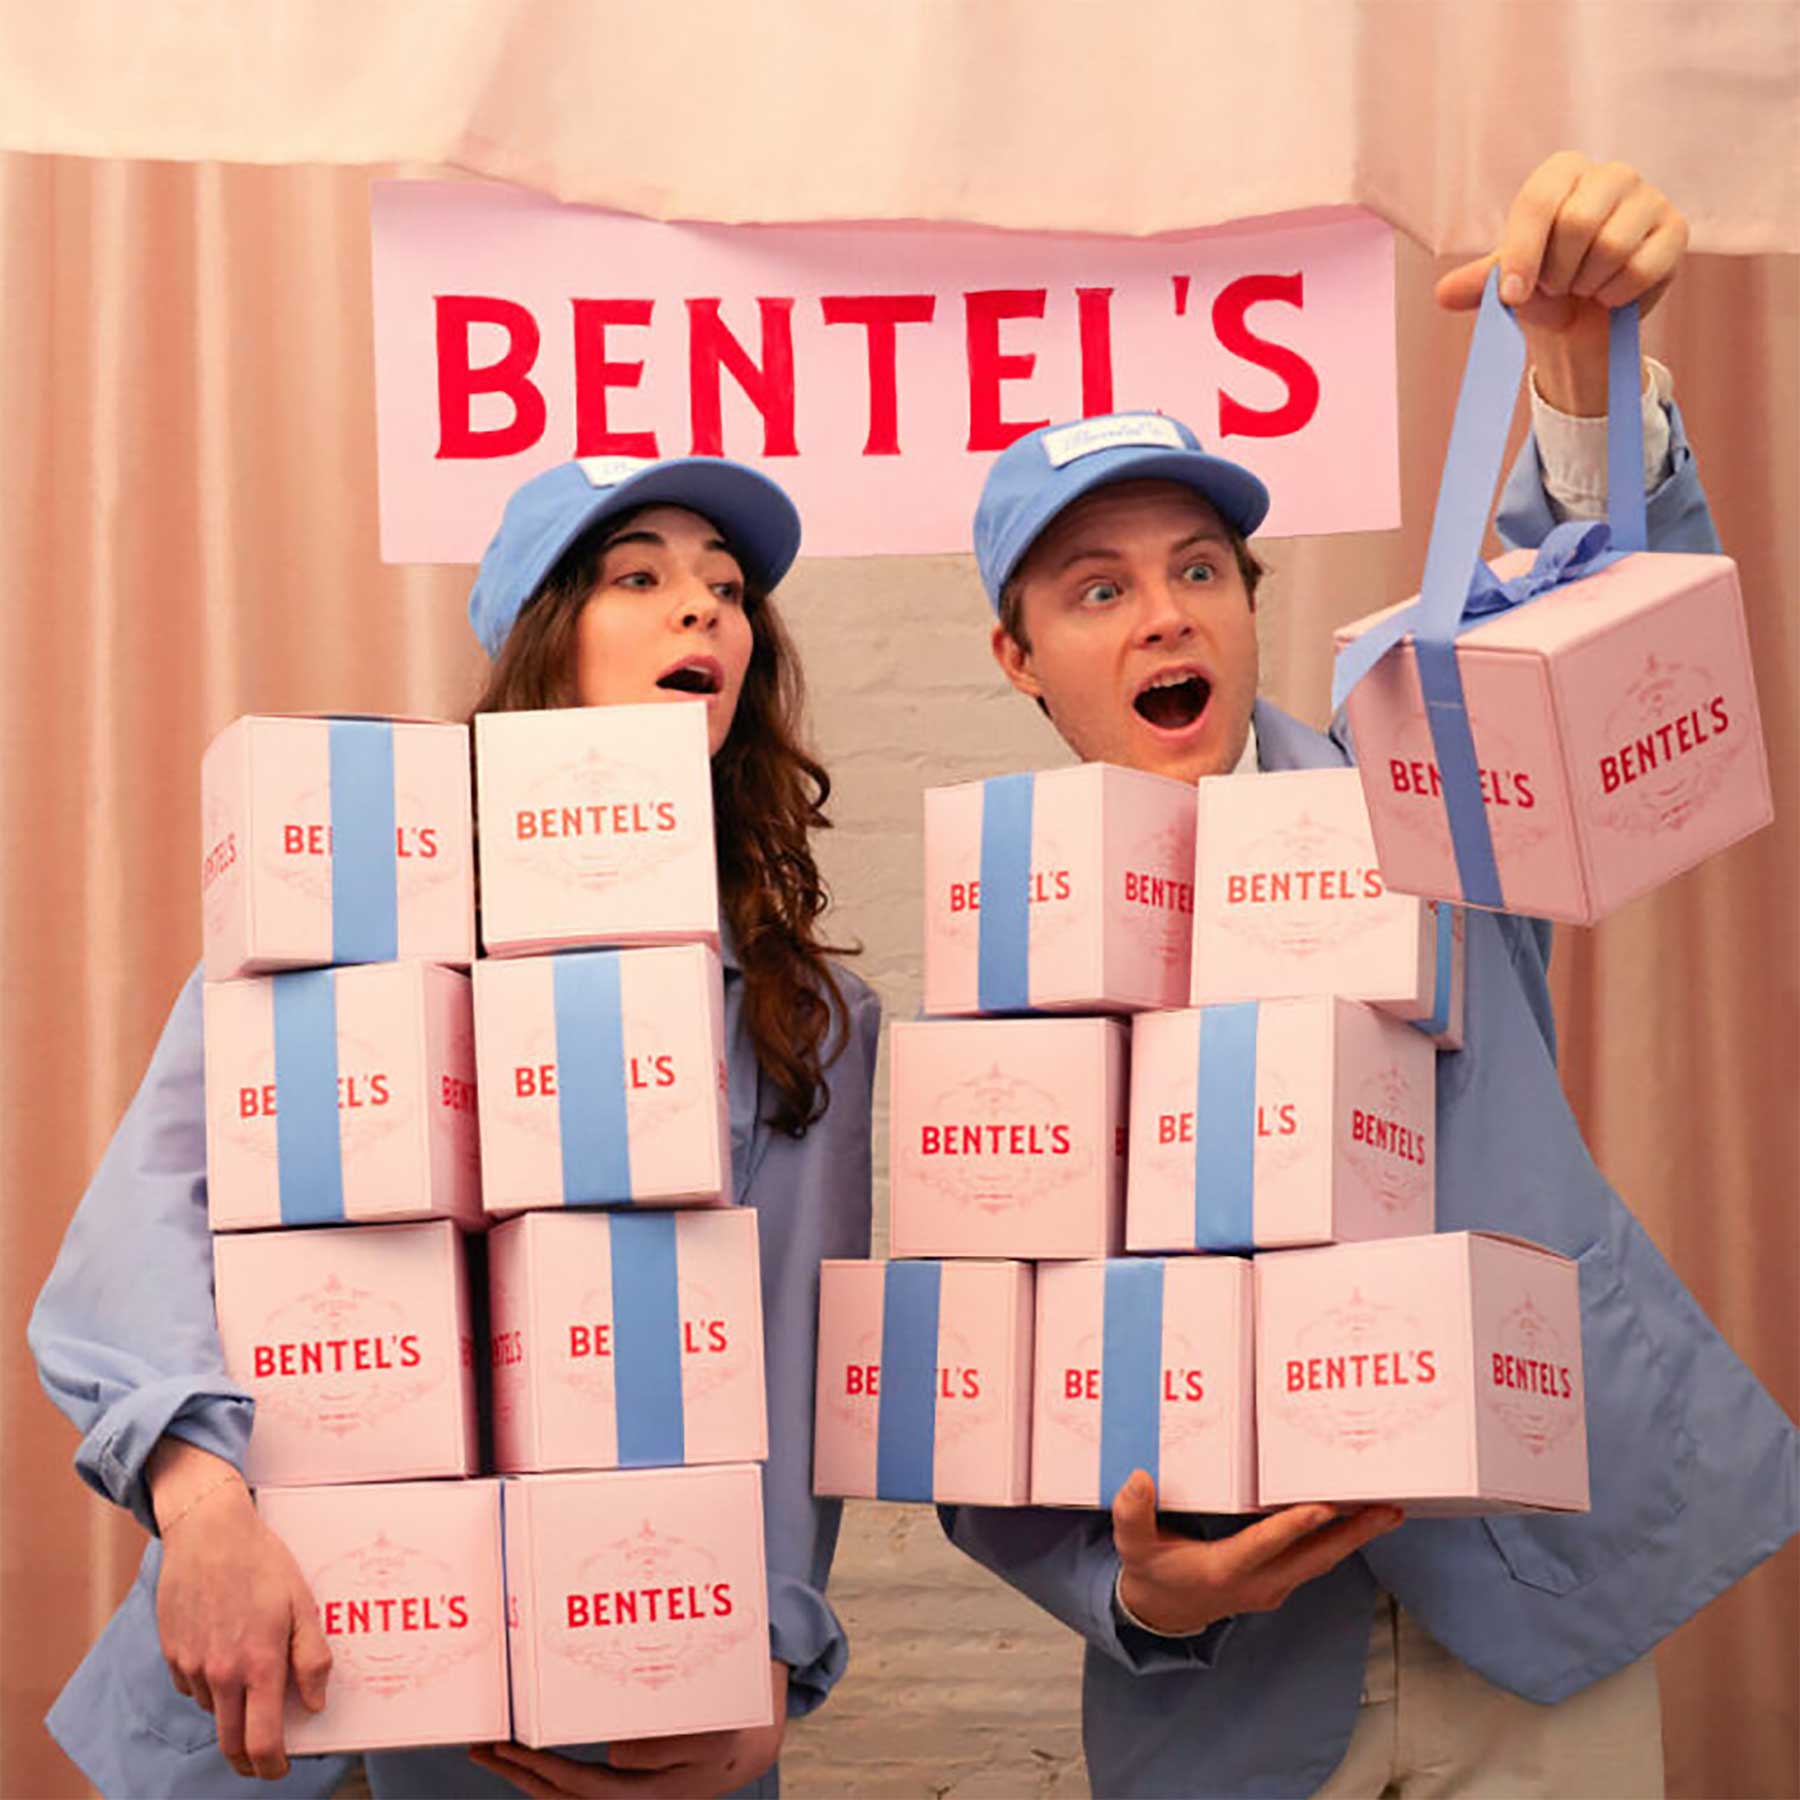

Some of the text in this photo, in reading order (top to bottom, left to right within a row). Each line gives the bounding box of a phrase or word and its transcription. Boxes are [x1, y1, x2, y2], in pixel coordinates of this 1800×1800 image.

[1599, 695, 1729, 795] BENTEL'S
[284, 824, 438, 859] BEL'S
[516, 802, 677, 841] BENTEL'S
[1228, 868, 1384, 905] BENTEL'S
[514, 1055, 676, 1099] BEL'S
[921, 1123, 1071, 1156] BENTEL'S
[1159, 1103, 1297, 1145] BEL'S
[254, 1334, 422, 1379] BENTEL'S
[569, 1319, 728, 1359] BEL'S
[846, 1364, 980, 1400] BEL'S
[1064, 1368, 1204, 1403] BEL'S
[1286, 1349, 1436, 1393] BENTEL'S
[315, 1594, 469, 1635] ENTEL'S
[566, 1583, 733, 1629] BENTEL'S
